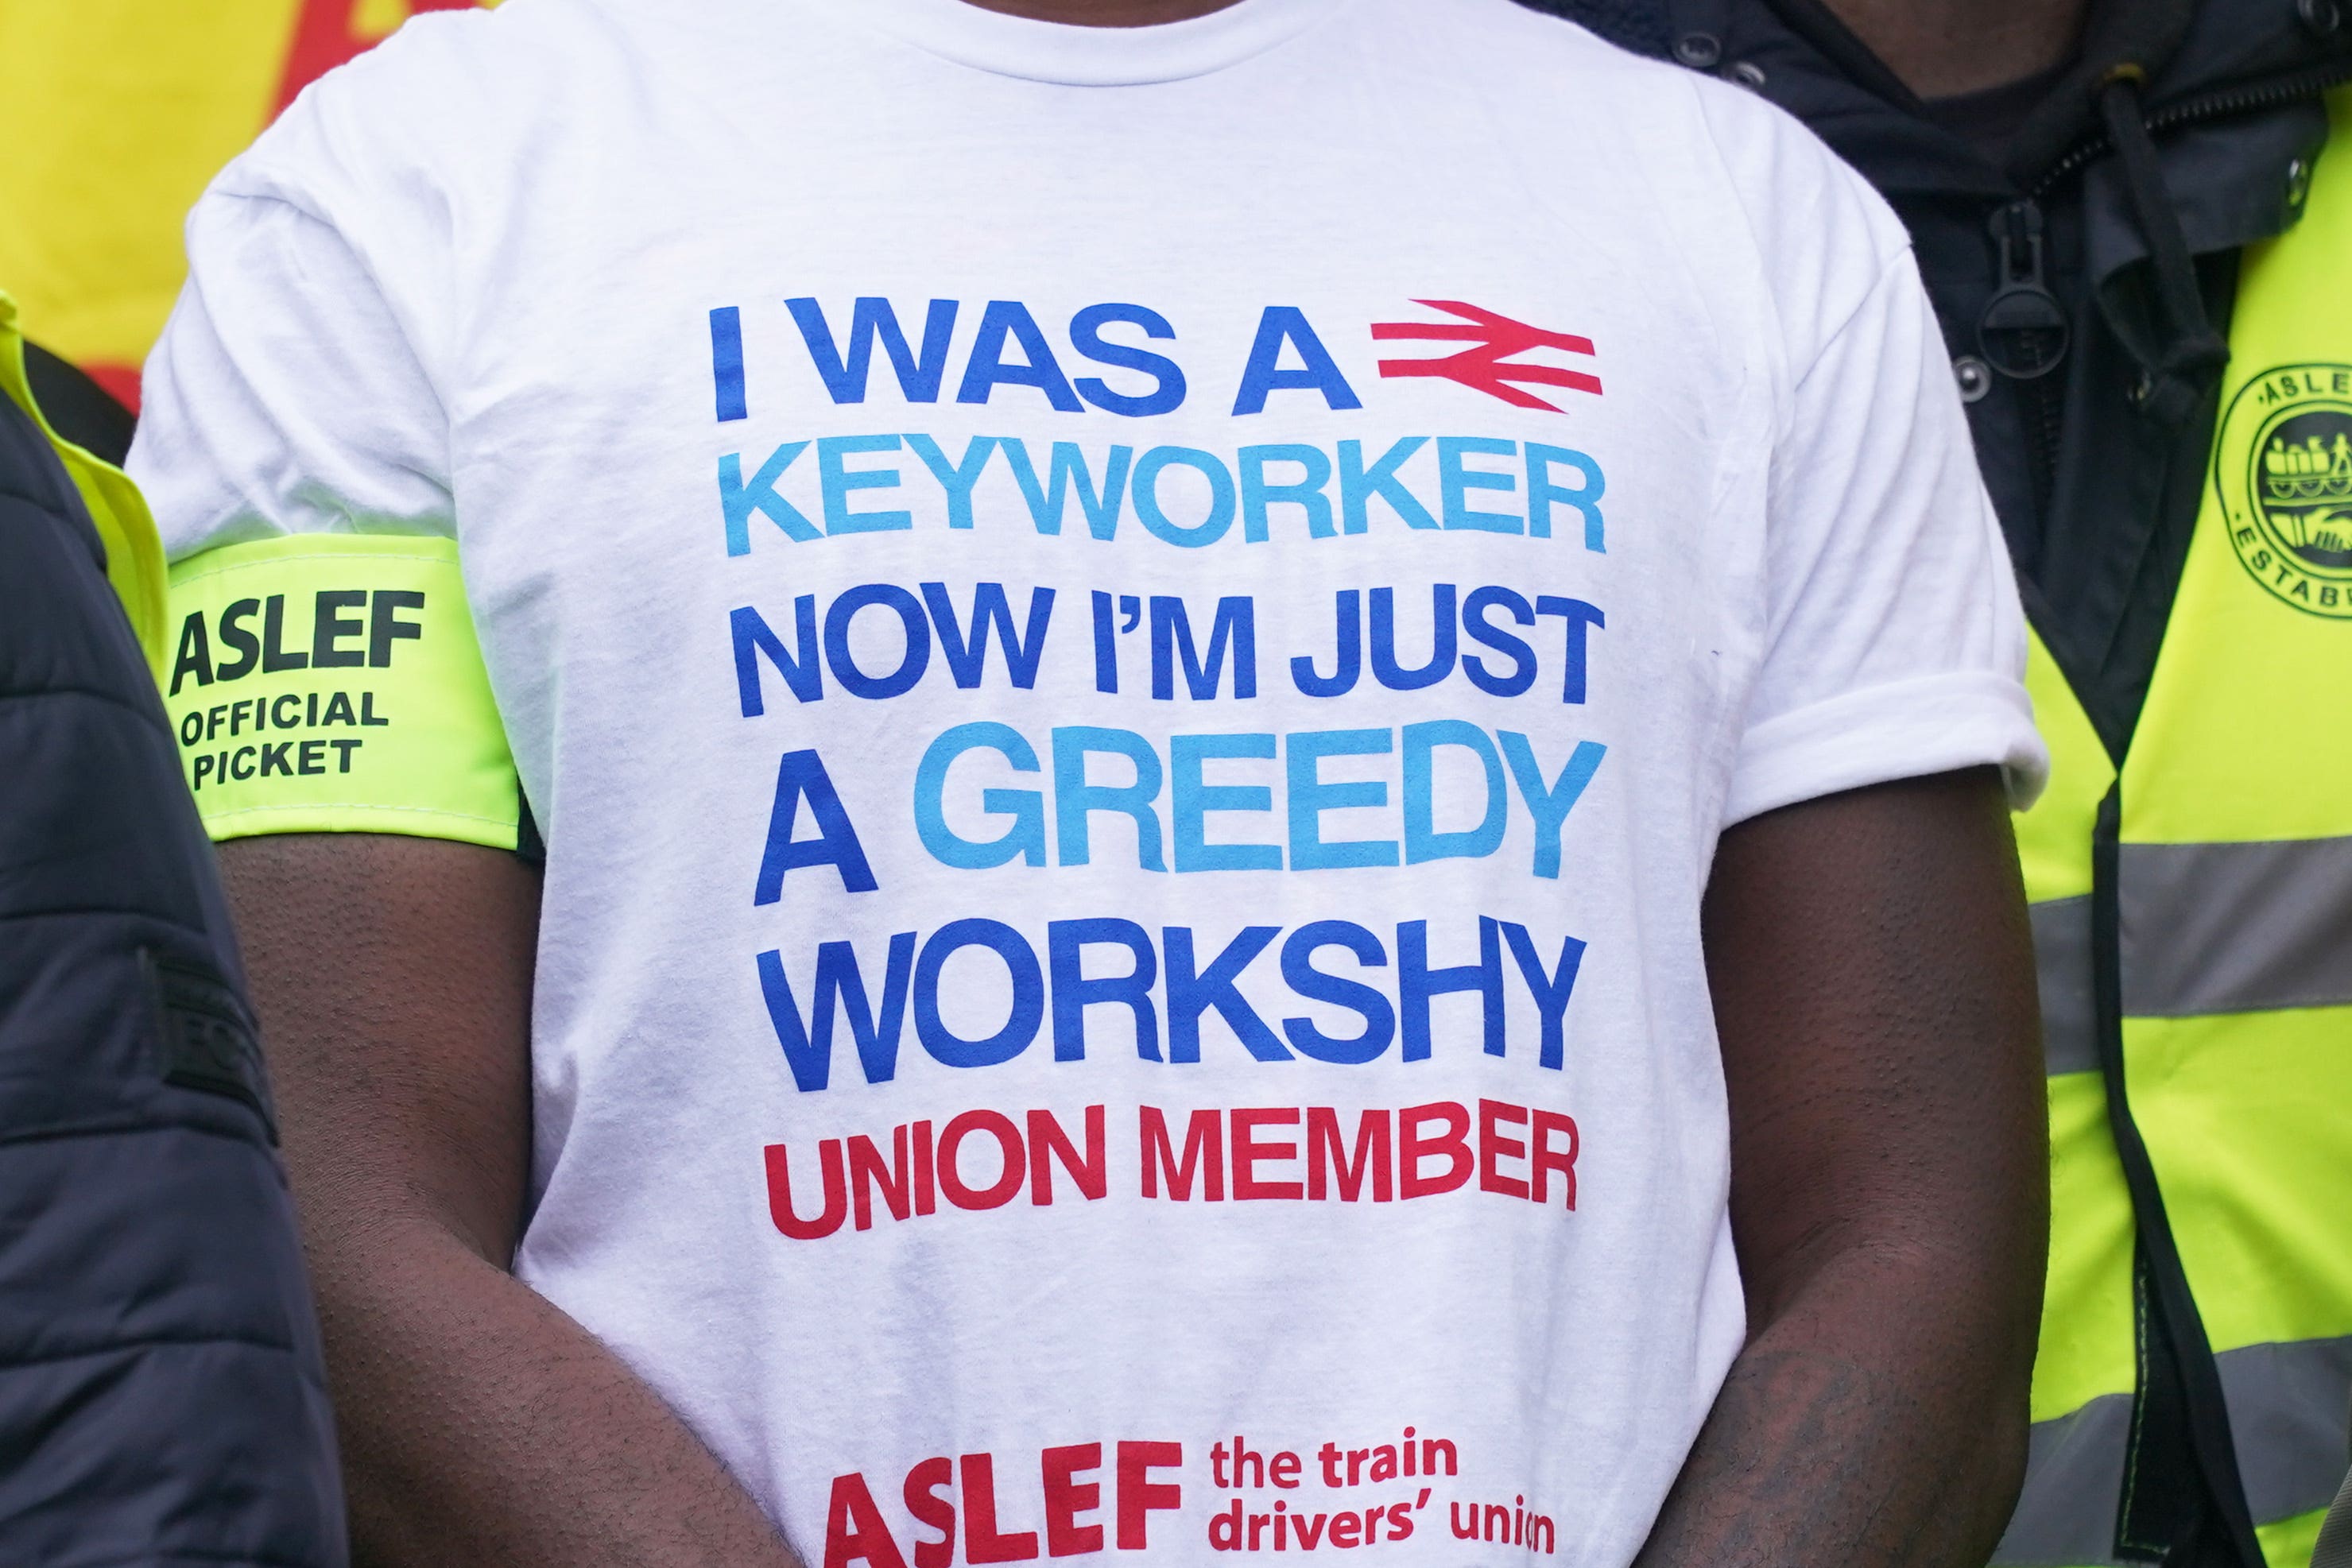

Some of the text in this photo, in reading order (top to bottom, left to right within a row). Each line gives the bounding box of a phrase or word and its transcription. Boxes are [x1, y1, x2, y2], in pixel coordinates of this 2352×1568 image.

[709, 297, 1362, 422] I WAS A
[718, 434, 1606, 558] KEYWORKER
[169, 590, 424, 698] ASLEF
[730, 582, 1605, 718] NOW I'M JUST
[180, 691, 389, 747] OFFICIAL
[193, 739, 363, 792] PICKET
[754, 722, 1607, 906] A GREEDY
[756, 916, 1587, 1092] WORKSHY
[765, 1099, 1579, 1240] UNION MEMBER
[823, 1440, 1183, 1568] ASLEF
[1211, 1426, 1458, 1489] the train
[1208, 1488, 1555, 1554] drivers' union
